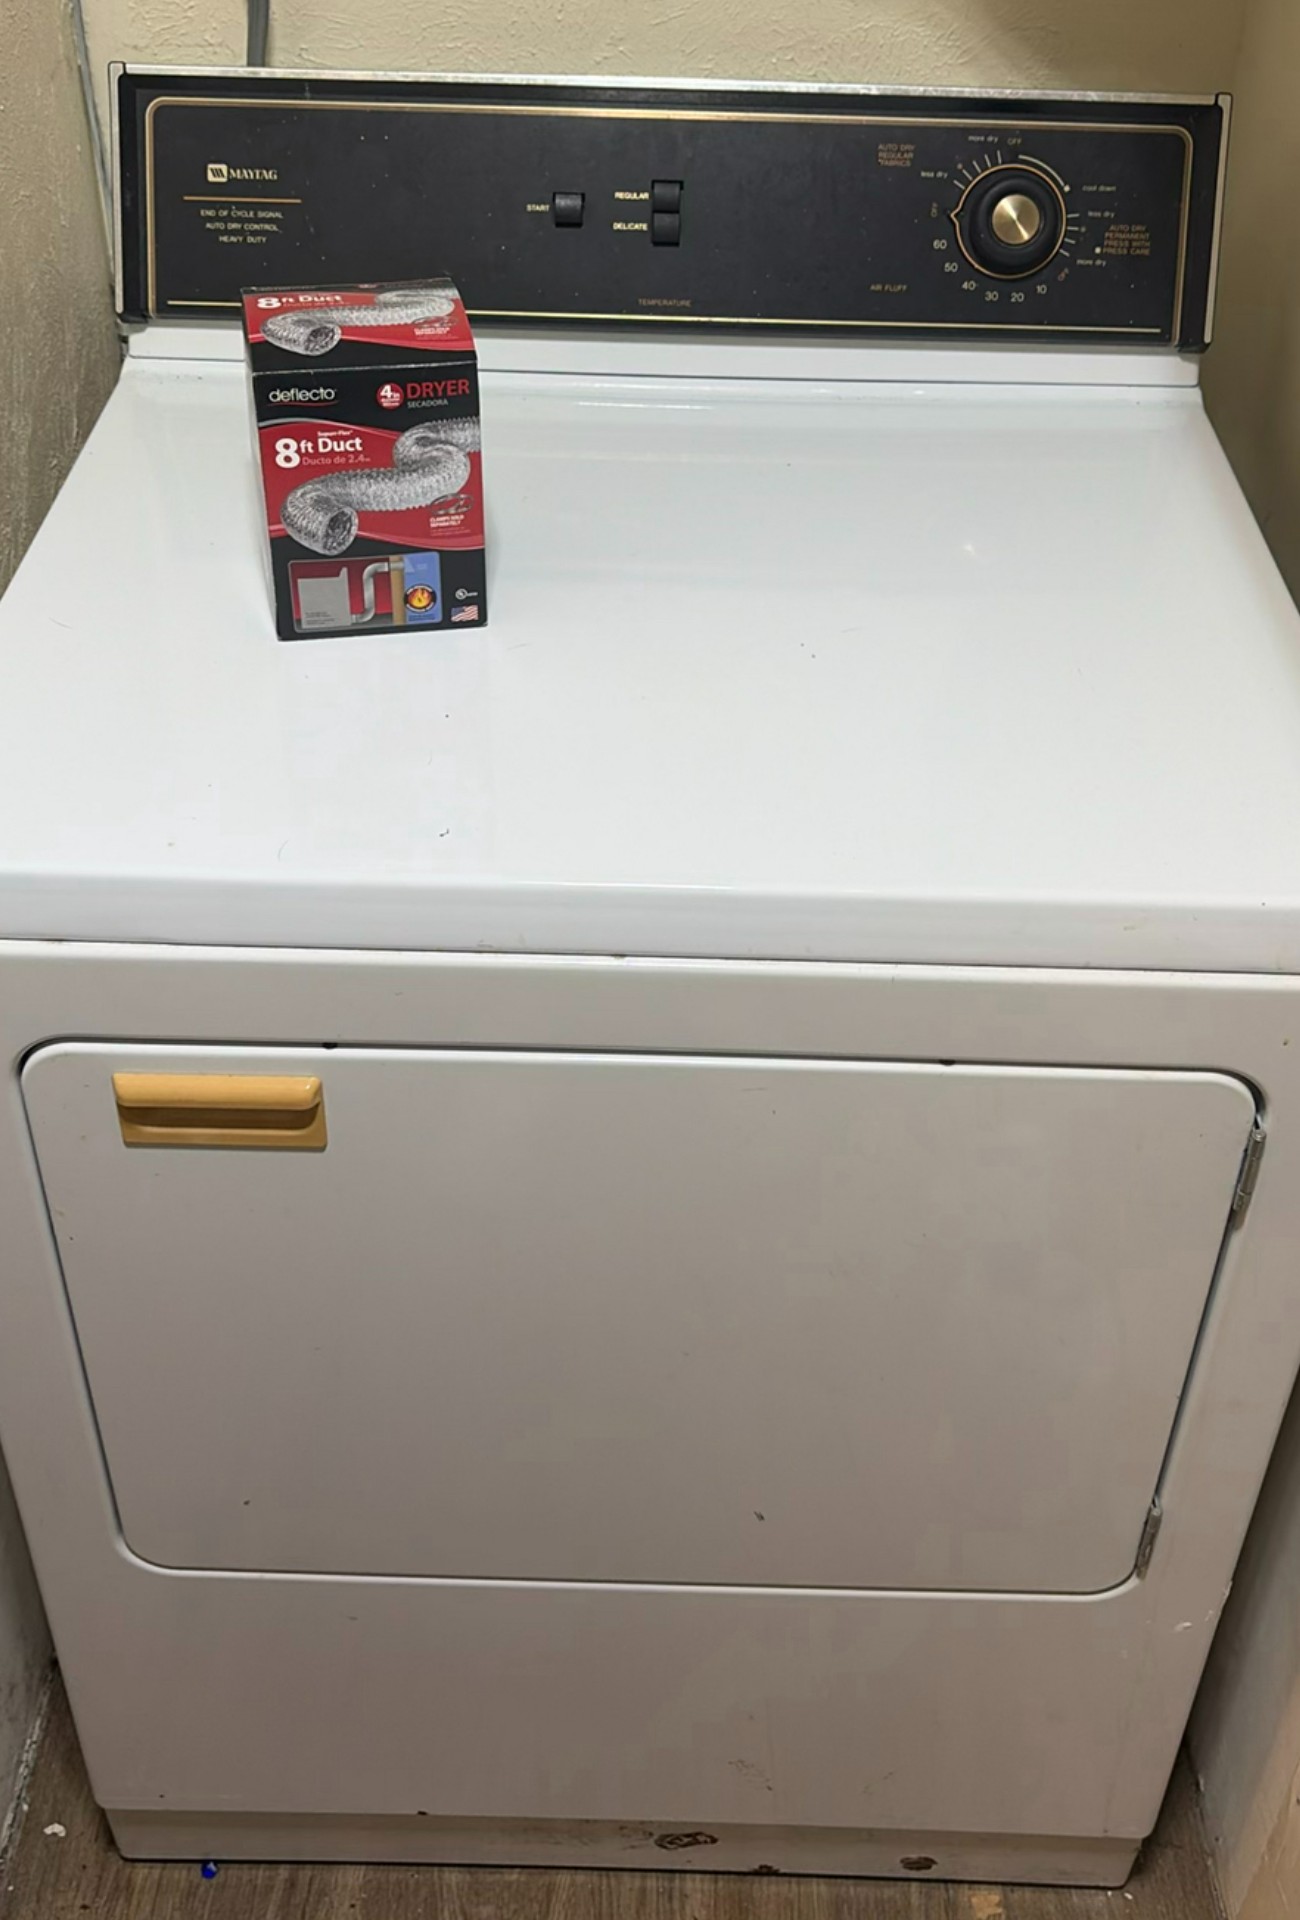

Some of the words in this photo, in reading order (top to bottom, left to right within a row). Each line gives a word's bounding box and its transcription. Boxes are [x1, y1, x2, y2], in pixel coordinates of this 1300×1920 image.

[986, 135, 999, 145] dry
[1007, 137, 1023, 146] OFF
[878, 143, 898, 151] AUTO
[878, 151, 914, 159] REGULAR
[229, 168, 278, 181] MAYTAG
[936, 171, 948, 180] dry
[614, 191, 649, 200] REGULAR
[526, 204, 550, 212] START
[200, 209, 216, 217] END
[231, 210, 254, 218] CYCLE
[257, 211, 284, 219] SIGNAL
[206, 222, 226, 230] AUTO
[243, 223, 279, 231] CONTROL
[612, 222, 648, 231] DELICATE
[219, 235, 243, 243] HEAVY
[1105, 232, 1150, 240] PERMANENT
[933, 239, 947, 250] 60
[1131, 248, 1150, 256] CARE
[944, 262, 958, 273] 50
[870, 284, 883, 292] AIR
[885, 284, 908, 293] FLUFF
[961, 281, 976, 291] 40
[1036, 284, 1048, 295] 10
[257, 296, 281, 309] 8
[298, 294, 343, 302] Duct
[985, 291, 999, 302] 30
[1010, 292, 1024, 303] 20
[638, 298, 692, 308] TEMPERATURE
[407, 379, 470, 398] DRYER
[268, 387, 336, 402] deflecto
[407, 398, 448, 408] SECADORA
[275, 438, 301, 468] 8
[300, 440, 314, 453] ft
[317, 437, 363, 453] Duct
[302, 457, 331, 466] Ducto
[333, 456, 346, 464] de
